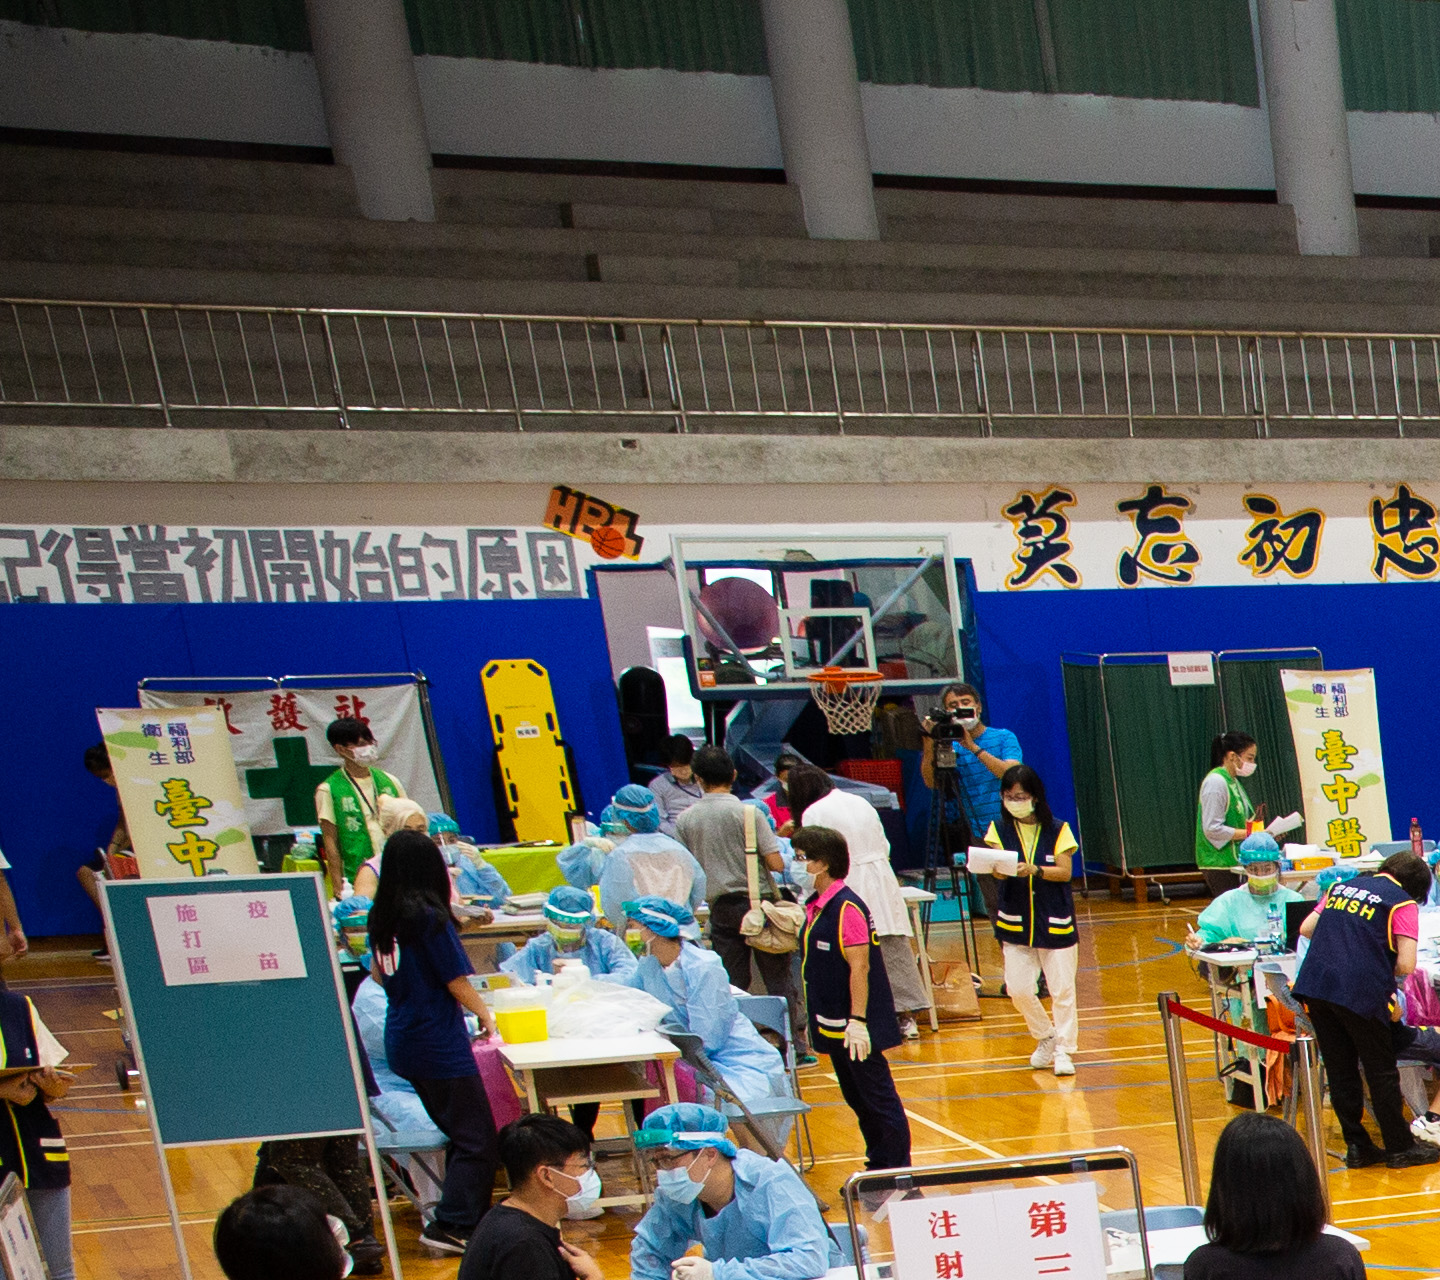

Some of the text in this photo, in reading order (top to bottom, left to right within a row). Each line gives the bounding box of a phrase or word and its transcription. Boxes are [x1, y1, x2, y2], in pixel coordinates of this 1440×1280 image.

[155, 777, 220, 876] 臺中
[175, 903, 209, 976] 施打區
[247, 900, 280, 972] 疫苗
[1325, 895, 1376, 921] CMSH
